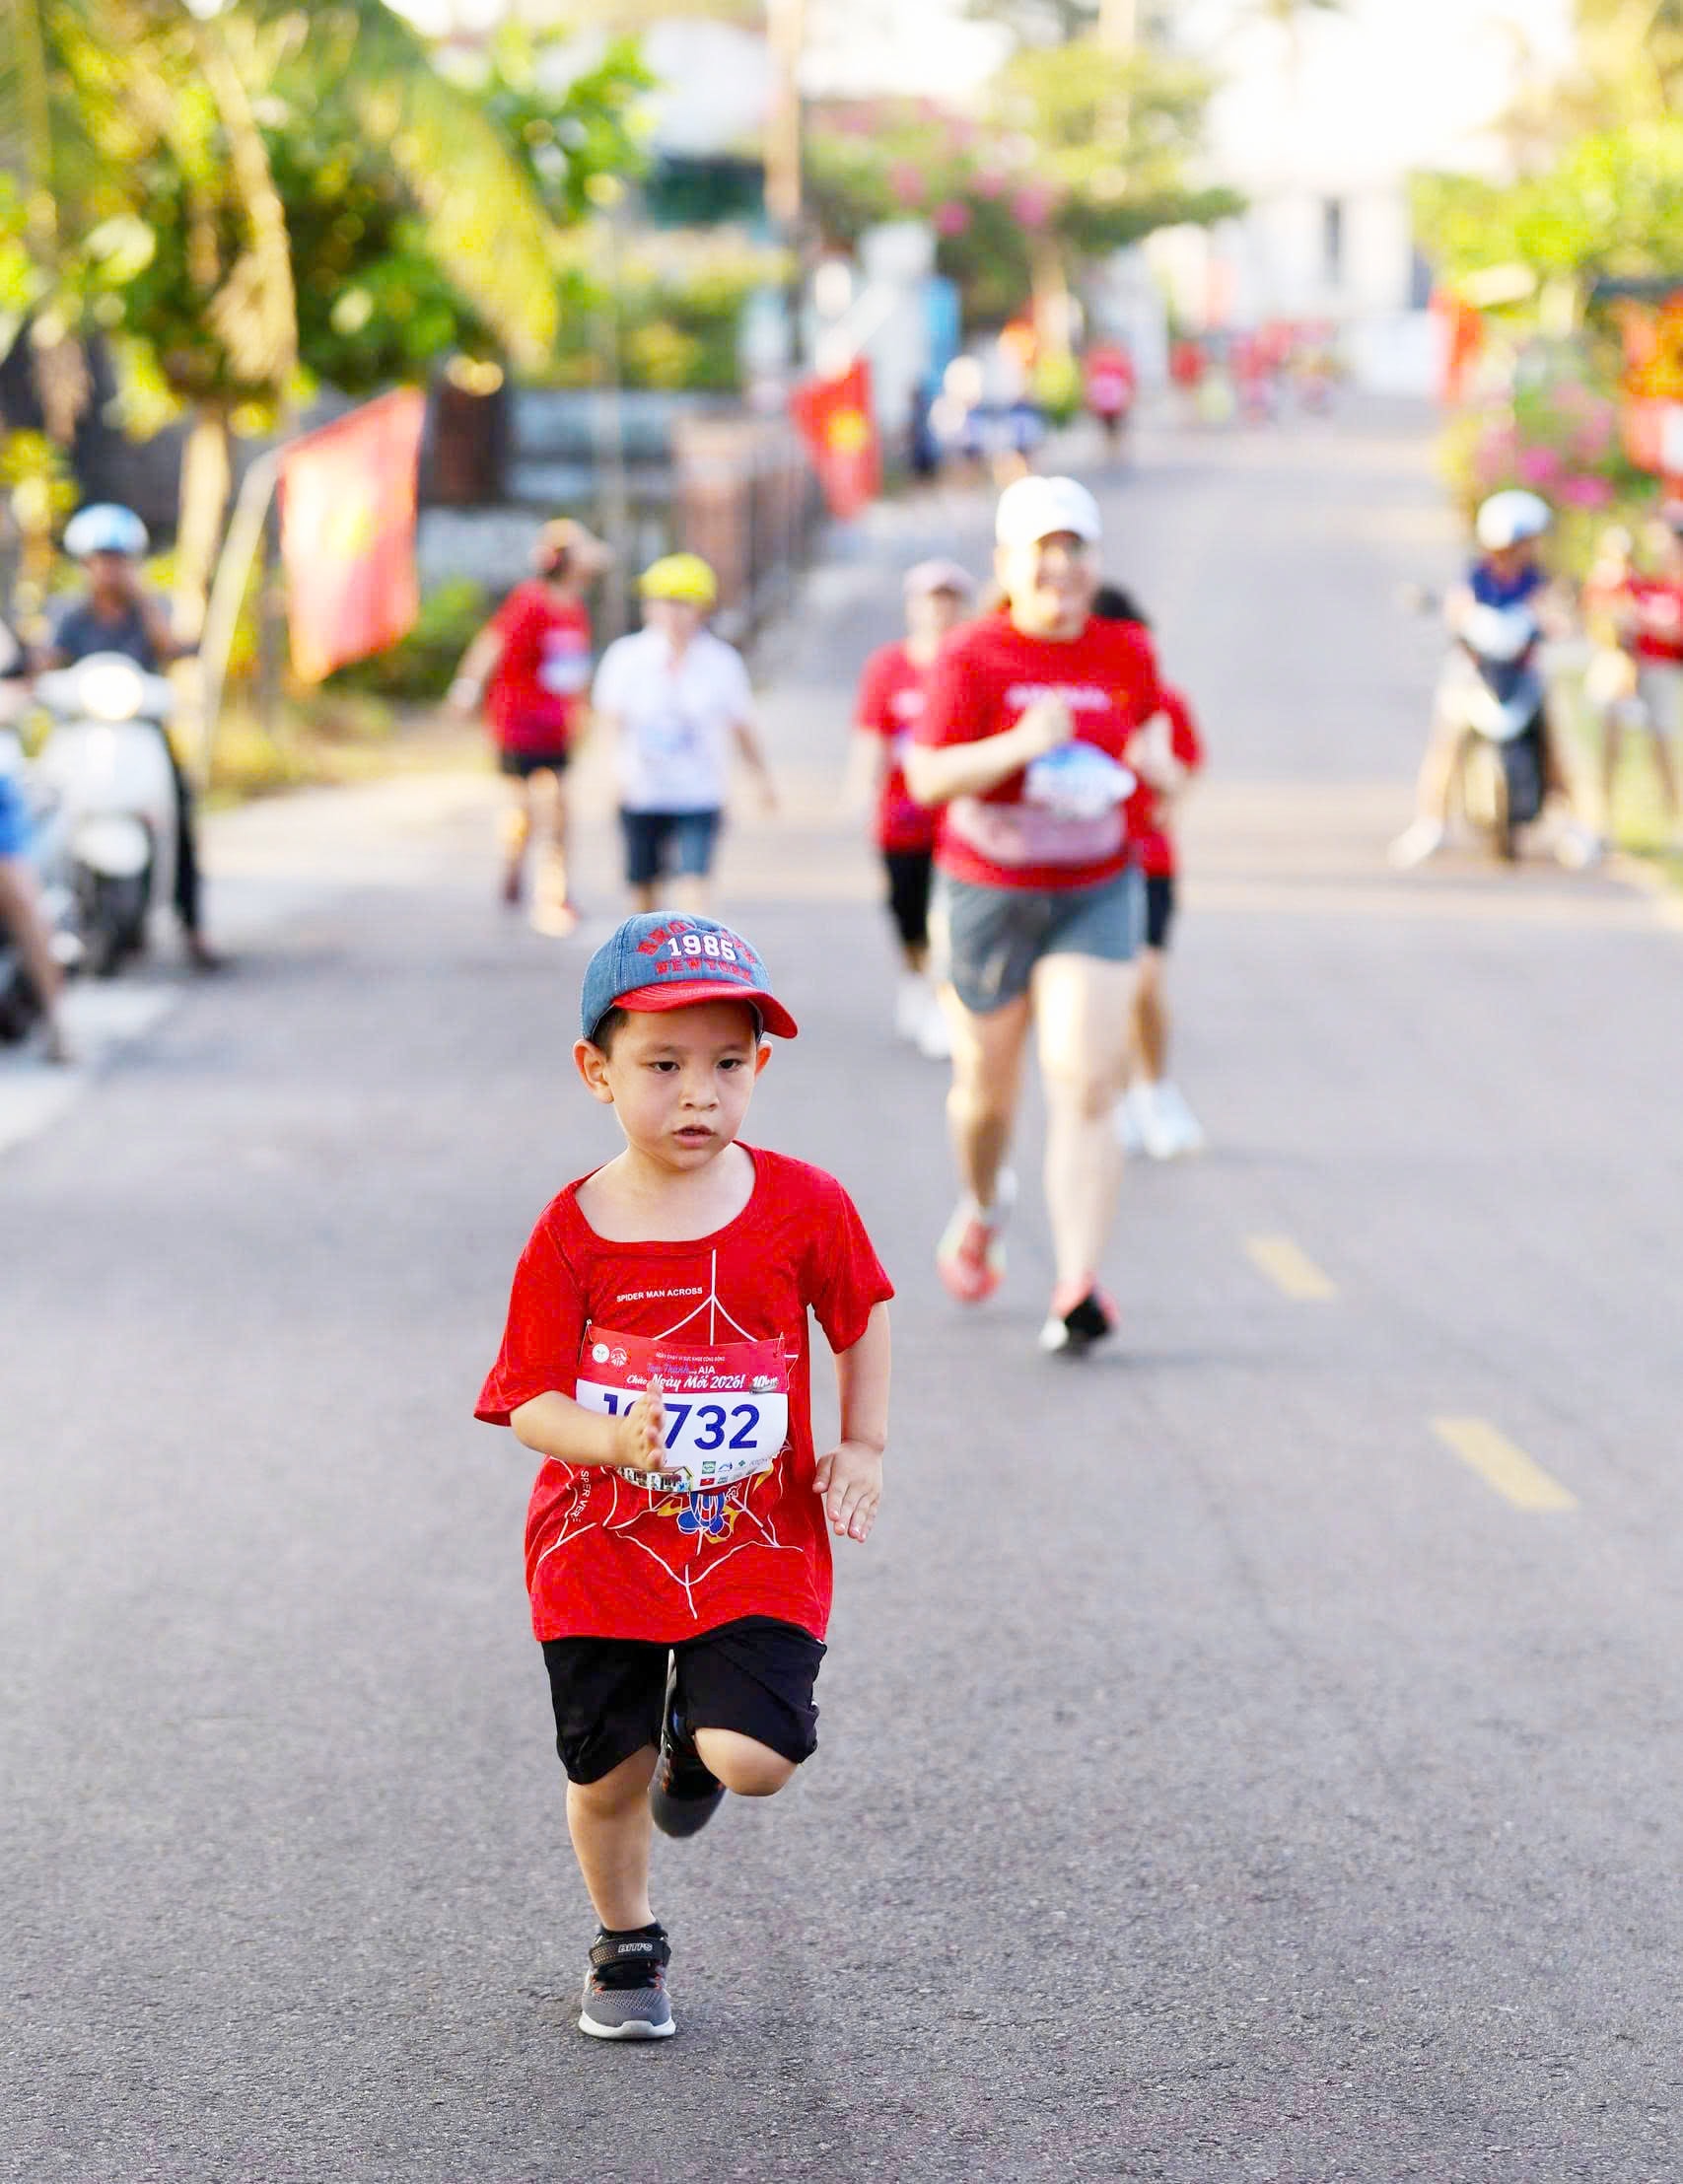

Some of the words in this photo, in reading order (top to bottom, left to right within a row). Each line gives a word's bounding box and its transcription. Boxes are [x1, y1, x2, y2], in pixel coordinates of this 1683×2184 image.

[667, 934, 737, 961] 1985
[616, 1292, 644, 1303] SPIDER
[646, 1290, 666, 1299] MAN
[666, 1287, 703, 1297] ACROSS
[698, 1366, 716, 1374] AIA
[710, 1374, 746, 1389] 2026!
[602, 1392, 760, 1450] 1732
